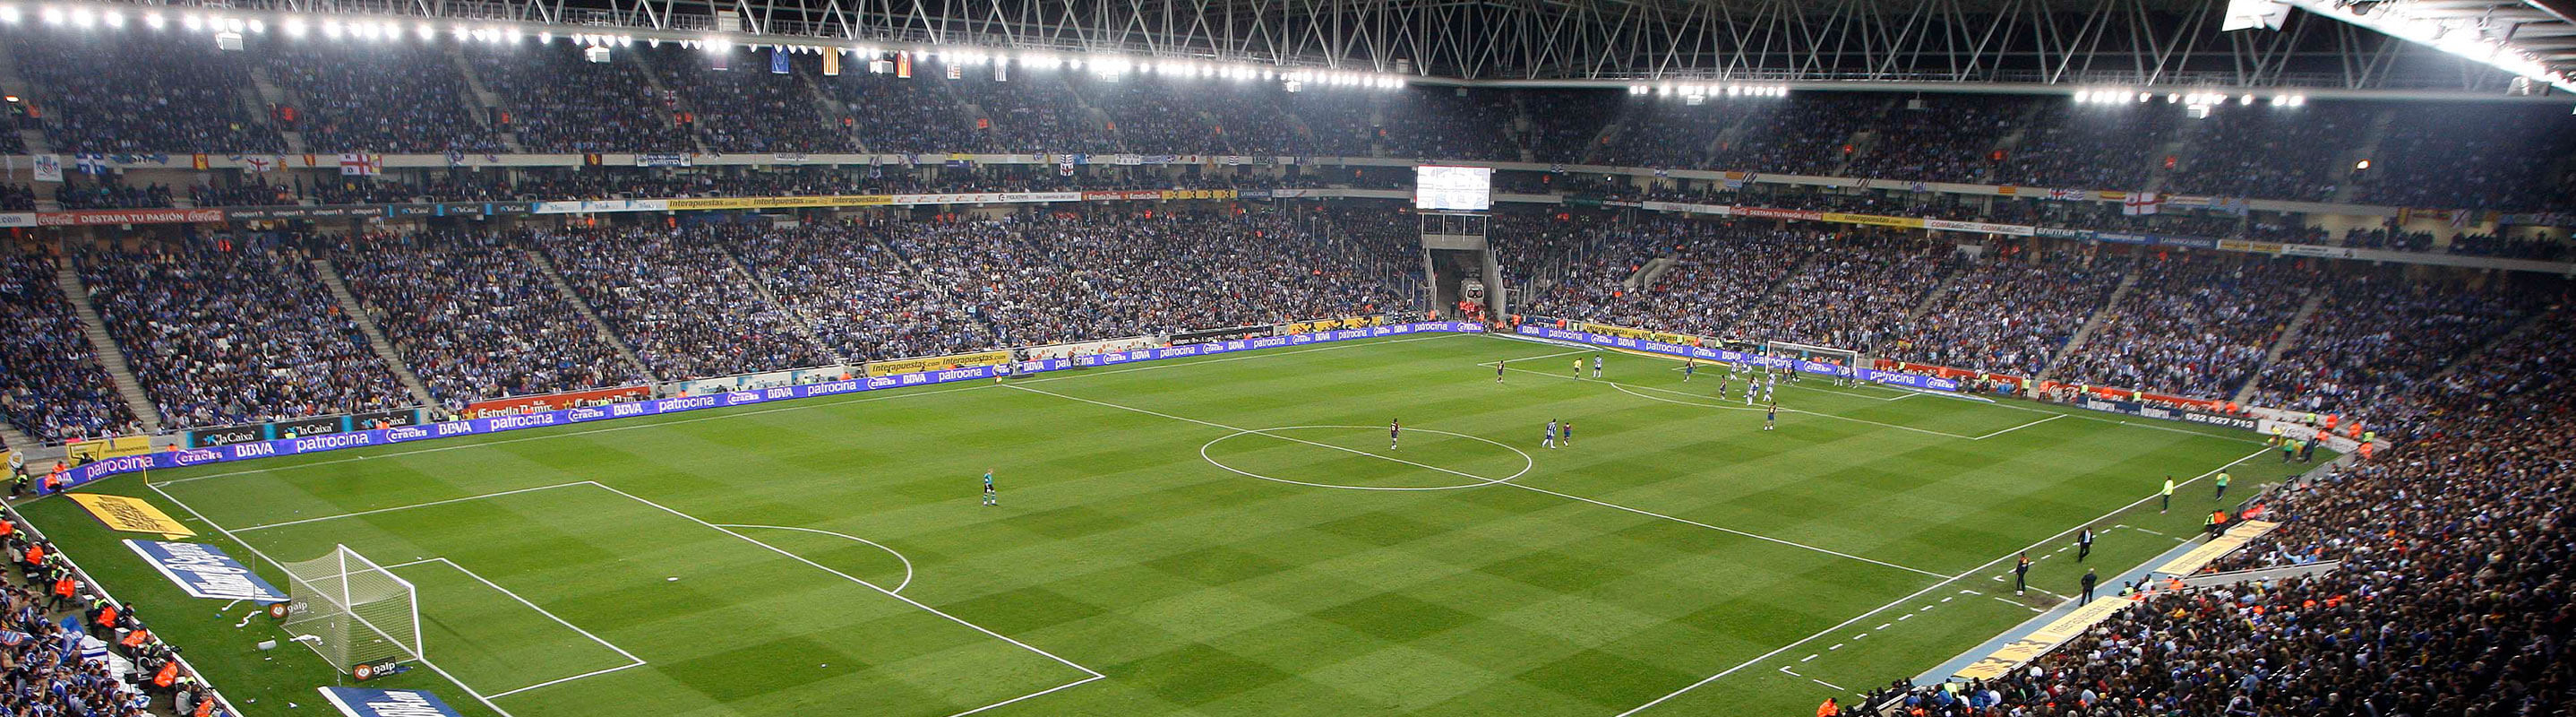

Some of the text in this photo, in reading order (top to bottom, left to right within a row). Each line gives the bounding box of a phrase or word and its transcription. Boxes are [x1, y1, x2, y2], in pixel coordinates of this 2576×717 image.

[81, 212, 184, 223] DESTAPA TU PASIÓN
[1315, 332, 1330, 341] BBVA
[1338, 328, 1367, 341] patrocina
[1394, 324, 1408, 333] BBVA
[1414, 323, 1447, 332] patrocina
[1522, 324, 1539, 334] BBVA
[1548, 329, 1583, 341] patrocina
[1228, 341, 1245, 350] BBVA
[1254, 336, 1285, 349] patrocina
[1618, 338, 1636, 348] BBVA
[1645, 341, 1683, 354] patrocina
[1131, 350, 1150, 360] BBVA
[1160, 346, 1195, 358] patrocina
[1722, 350, 1741, 361] BBVA
[1024, 360, 1044, 372] BBVA
[903, 373, 926, 384] BBVA
[938, 366, 983, 382] patrocina
[1870, 370, 1915, 384] patrocina
[767, 387, 794, 399] BBVA
[807, 379, 856, 396] patrocina
[613, 403, 643, 416] BBVA
[658, 394, 715, 413] patrocina
[438, 421, 473, 436] BBVA
[490, 412, 554, 432] patrocina
[235, 442, 275, 458] BBVA
[296, 432, 370, 453] patrocina
[87, 456, 155, 480] patrocina
[287, 602, 308, 614] galp
[373, 661, 396, 674] galp
